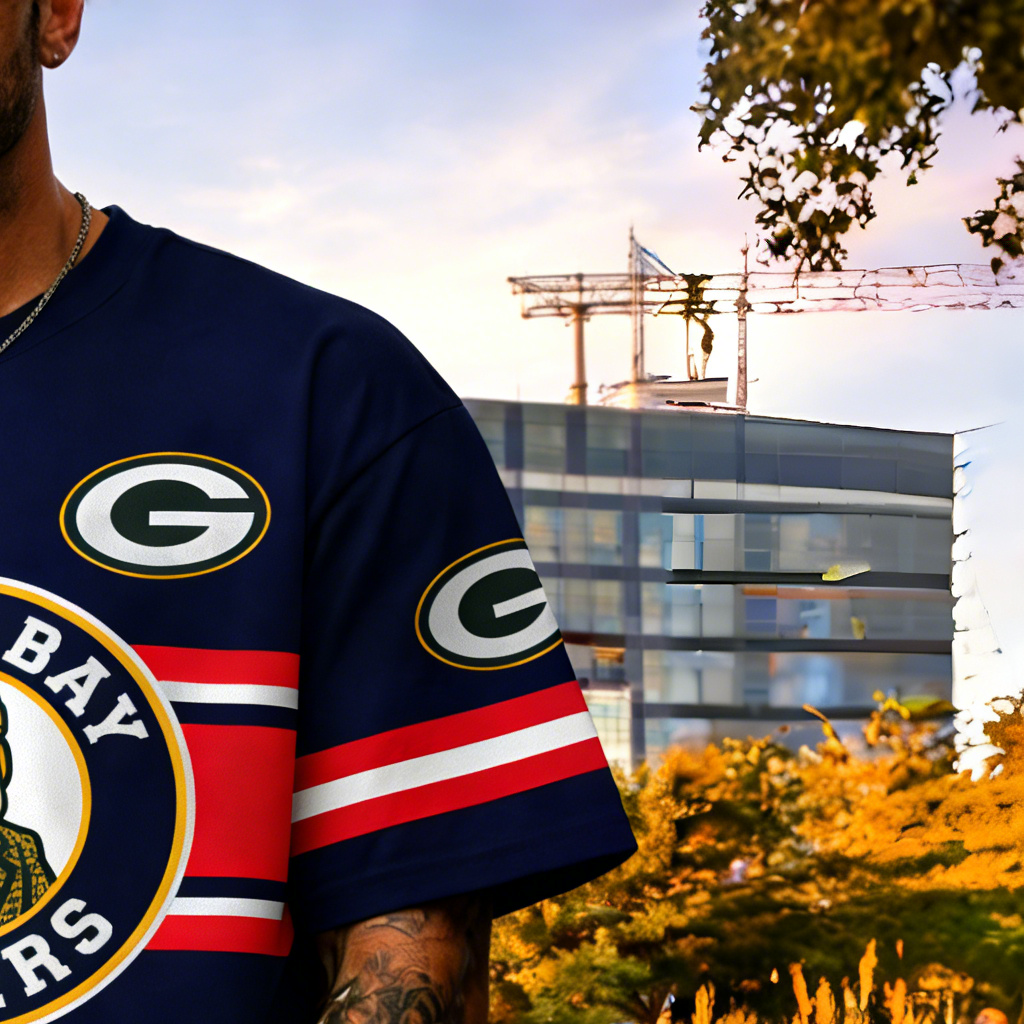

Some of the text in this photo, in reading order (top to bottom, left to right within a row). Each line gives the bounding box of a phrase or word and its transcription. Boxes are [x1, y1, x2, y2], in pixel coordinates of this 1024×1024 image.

[76, 463, 255, 567] G
[428, 548, 559, 659] G
[2, 615, 149, 745] BAY
